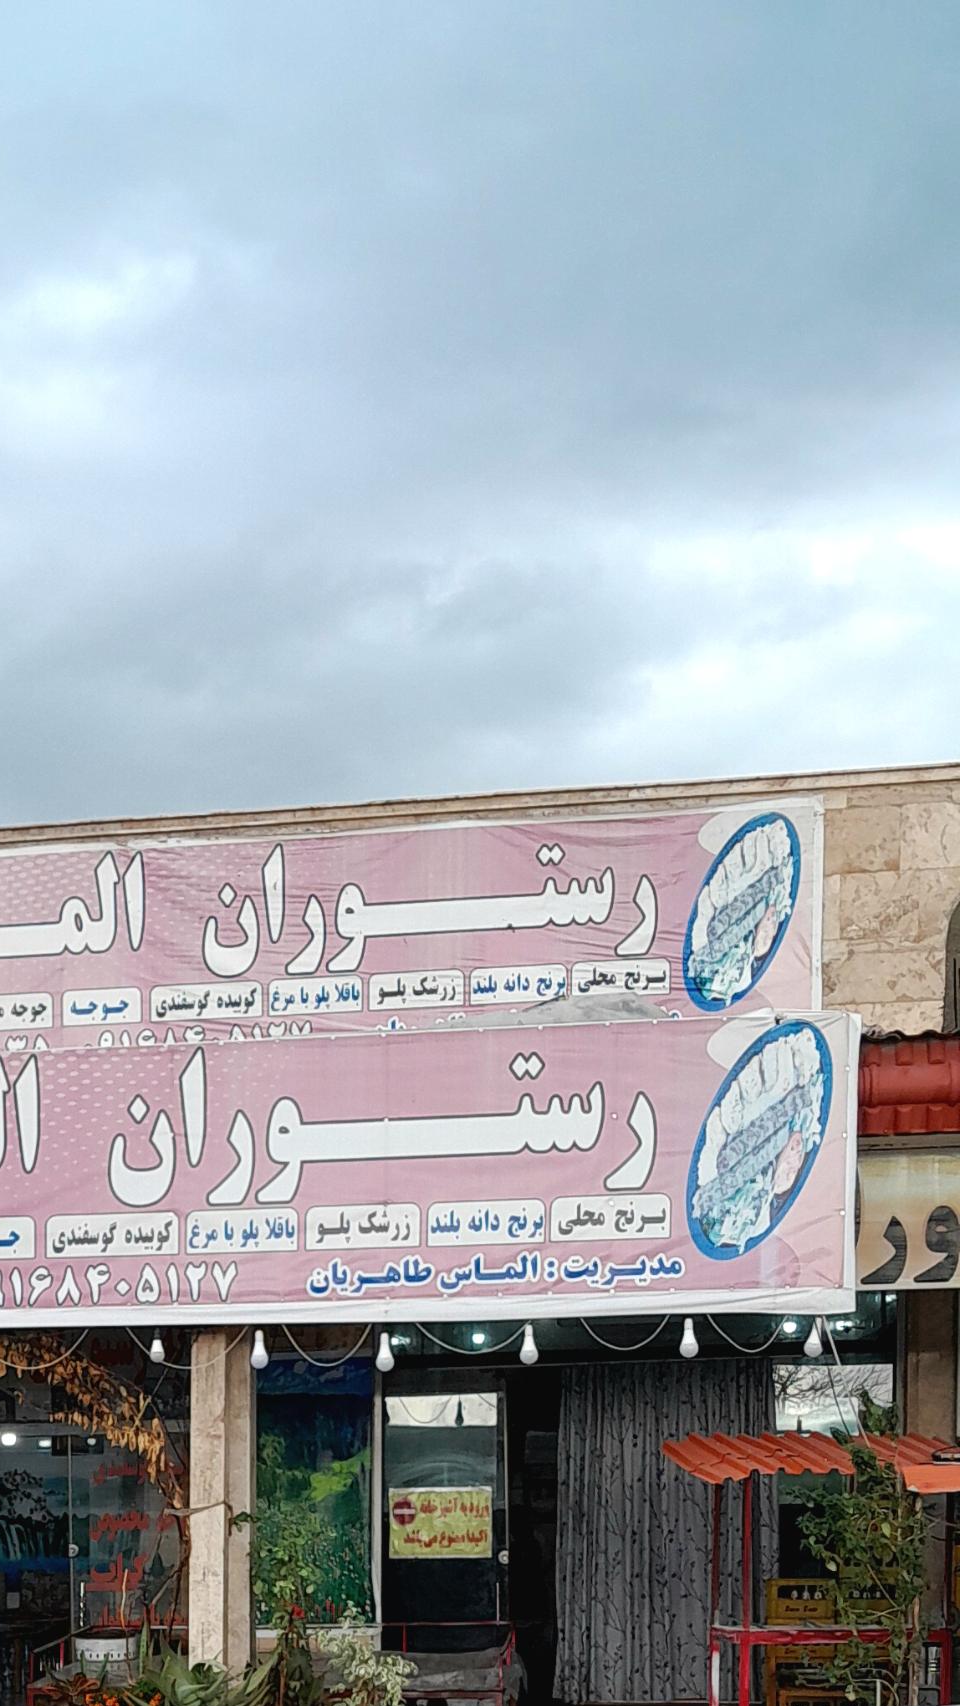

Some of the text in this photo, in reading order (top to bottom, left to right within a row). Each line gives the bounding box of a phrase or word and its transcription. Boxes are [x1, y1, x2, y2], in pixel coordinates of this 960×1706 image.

[202, 843, 658, 978] رستوران
[413, 976, 457, 1003] زرشک
[472, 971, 499, 996] بلند
[503, 972, 531, 992] دانه
[577, 964, 667, 994] برنج محلی
[10, 1002, 48, 1022] جوجه
[70, 1000, 130, 1021] جوجه
[109, 1045, 658, 1208] رستوران
[52, 1218, 173, 1254] کوبیده گوسفندی
[189, 1215, 296, 1250] باقلا پلو با مرغ
[315, 1209, 411, 1244] زرشک پلو
[431, 1208, 544, 1241] برنج دانه بلند
[557, 1202, 667, 1236] برنج محلی
[309, 1256, 432, 1296] طاهریان
[440, 1254, 539, 1290] الماس
